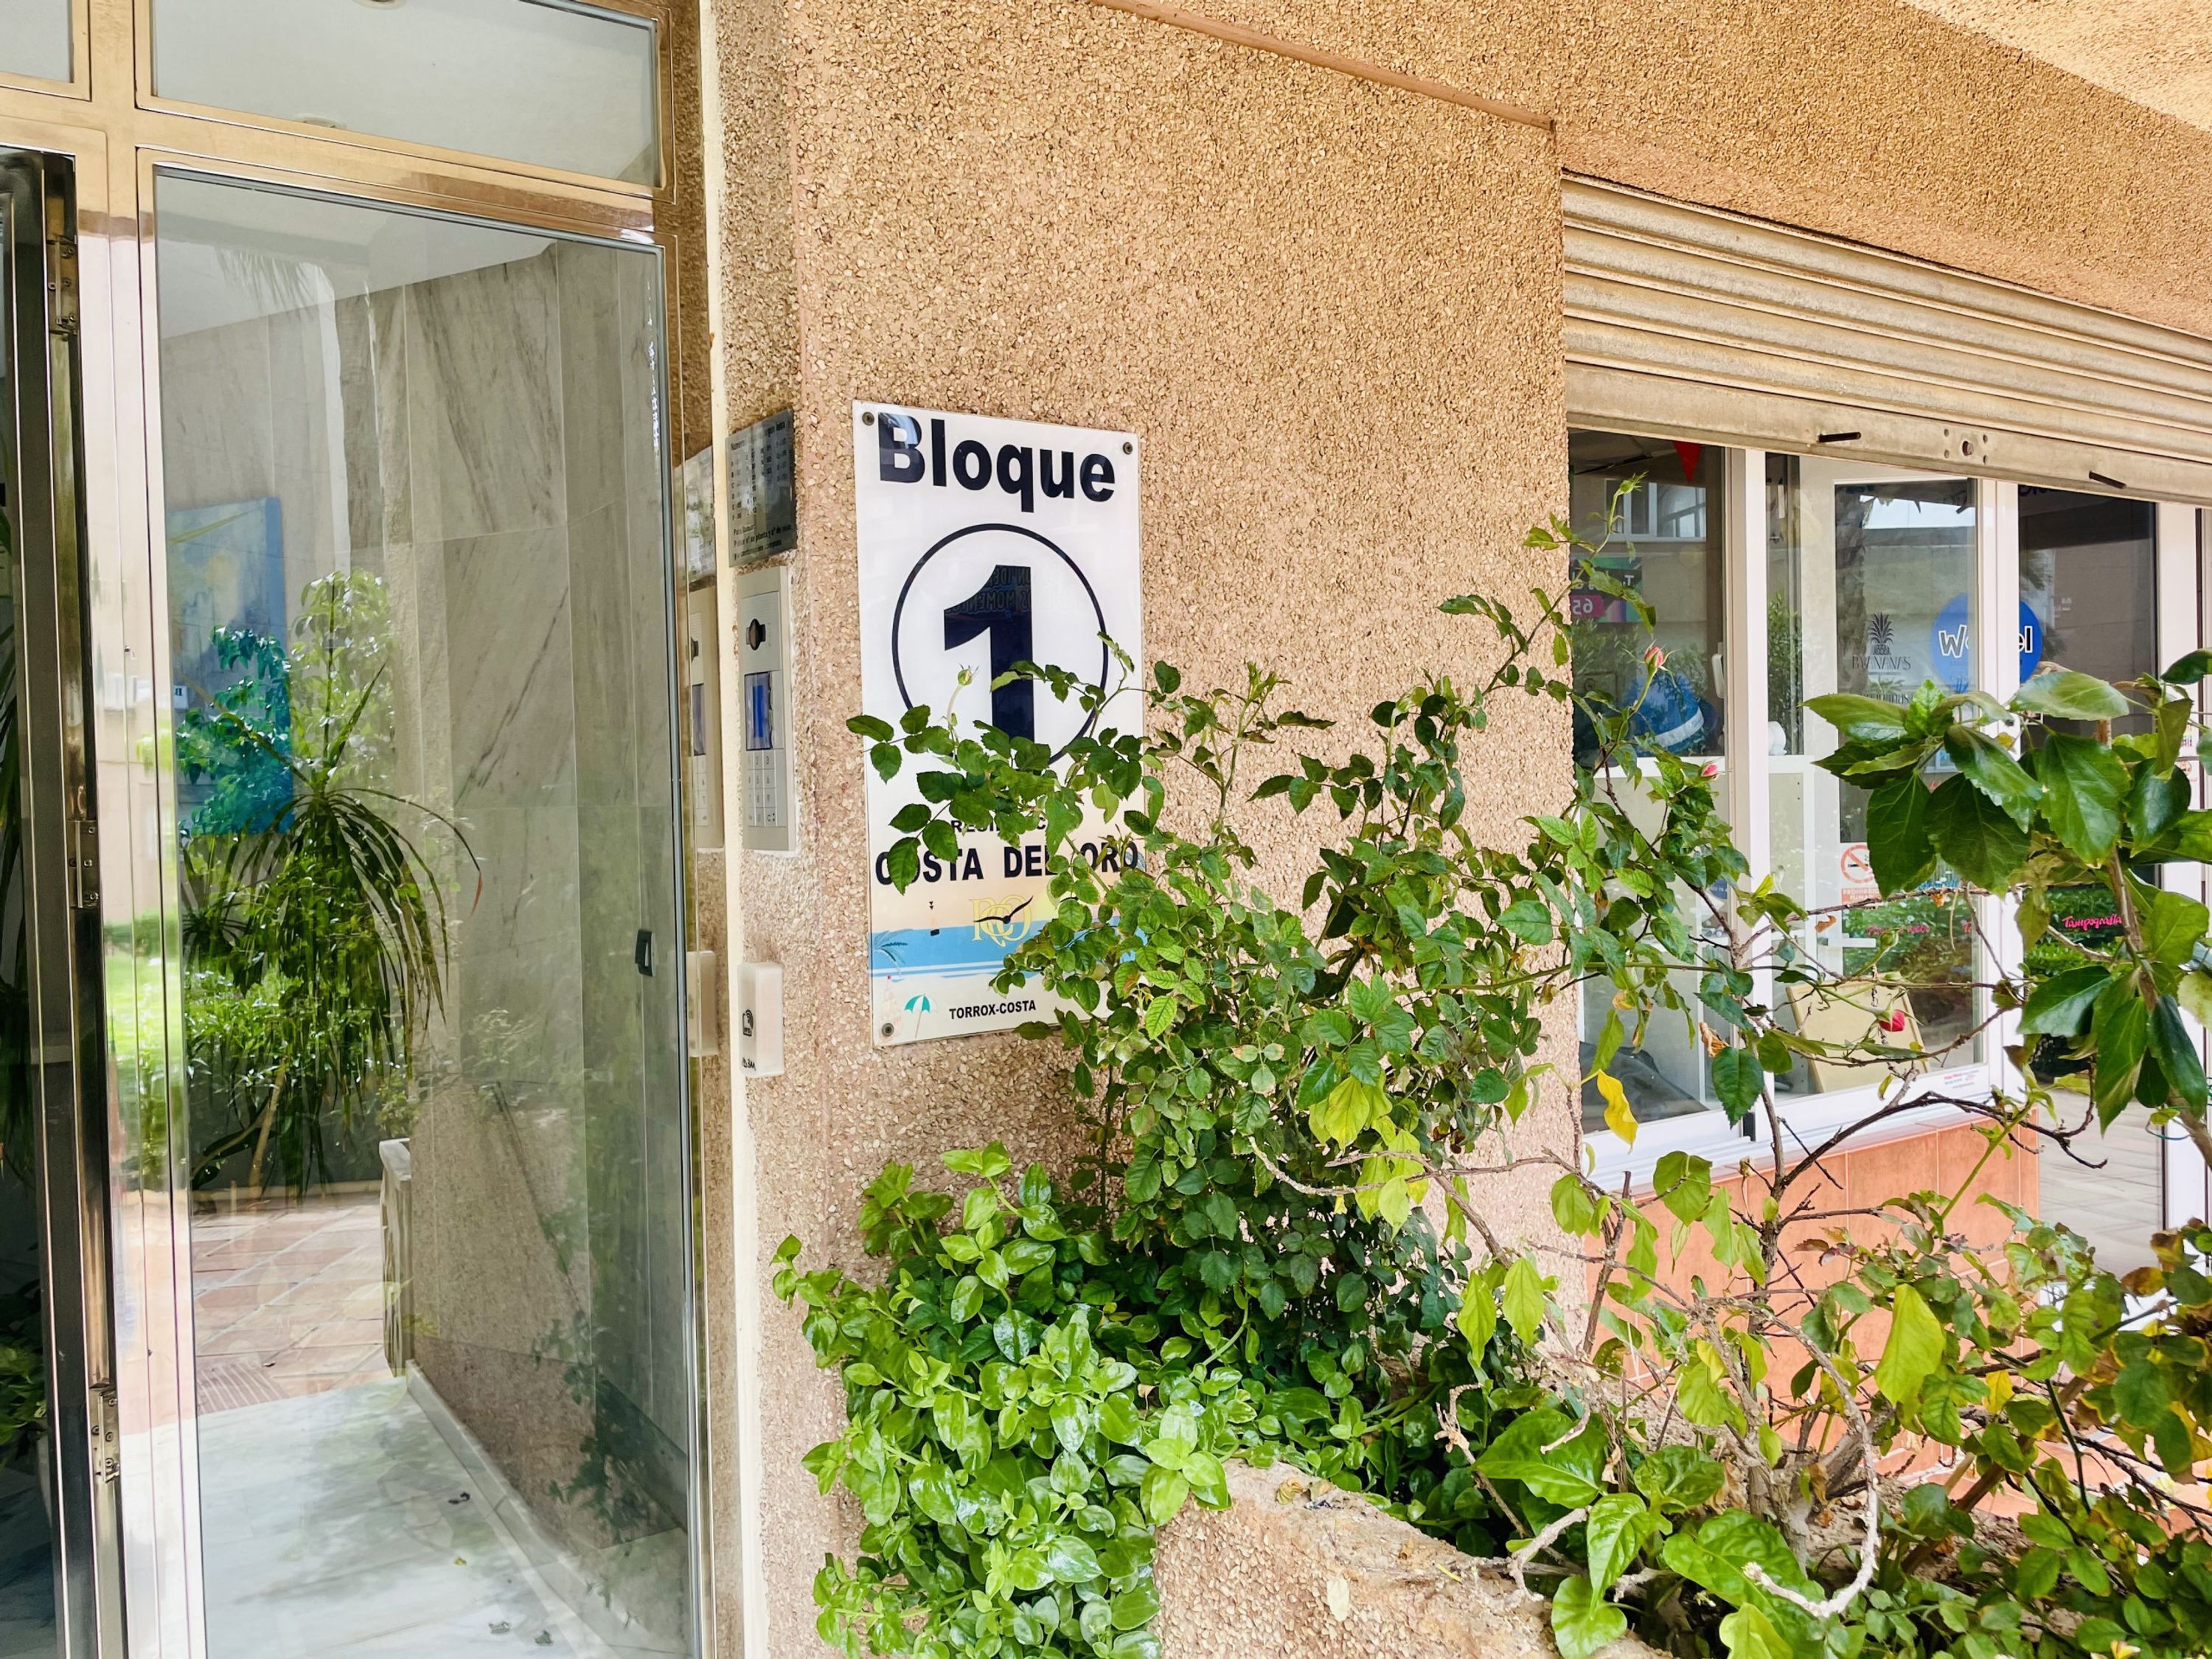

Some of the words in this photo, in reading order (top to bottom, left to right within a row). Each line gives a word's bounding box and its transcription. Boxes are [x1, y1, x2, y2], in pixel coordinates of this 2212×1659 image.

[877, 411, 1116, 513] Bloque
[944, 565, 1034, 746] 1
[875, 847, 984, 886] CSTA
[949, 1000, 1037, 1020] TORROX-COSTA
